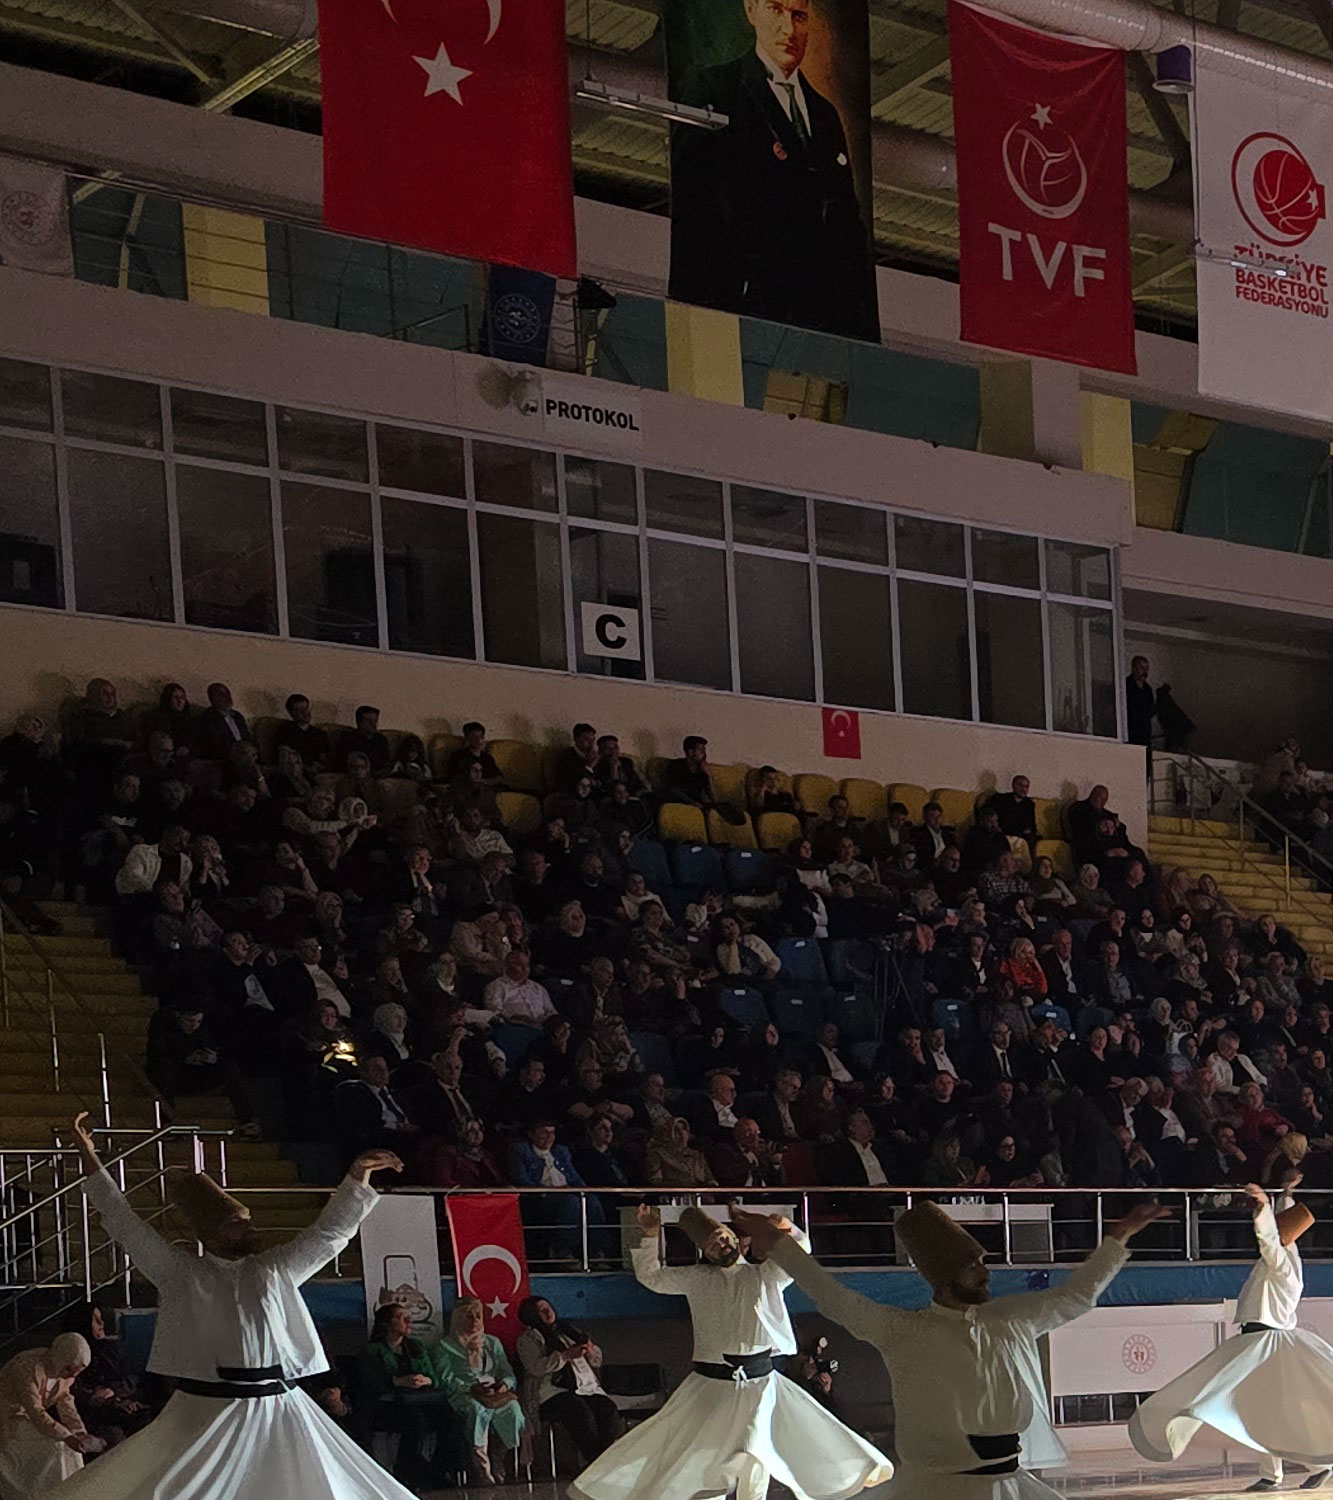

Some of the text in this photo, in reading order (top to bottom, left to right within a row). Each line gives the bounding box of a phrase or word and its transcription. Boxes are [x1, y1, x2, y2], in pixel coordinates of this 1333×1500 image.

[986, 222, 1107, 298] TVF
[1235, 286, 1329, 319] FEDERASYONU
[1236, 269, 1329, 305] BASKETBOL
[545, 399, 640, 431] PROTOKOL
[595, 613, 628, 650] C
